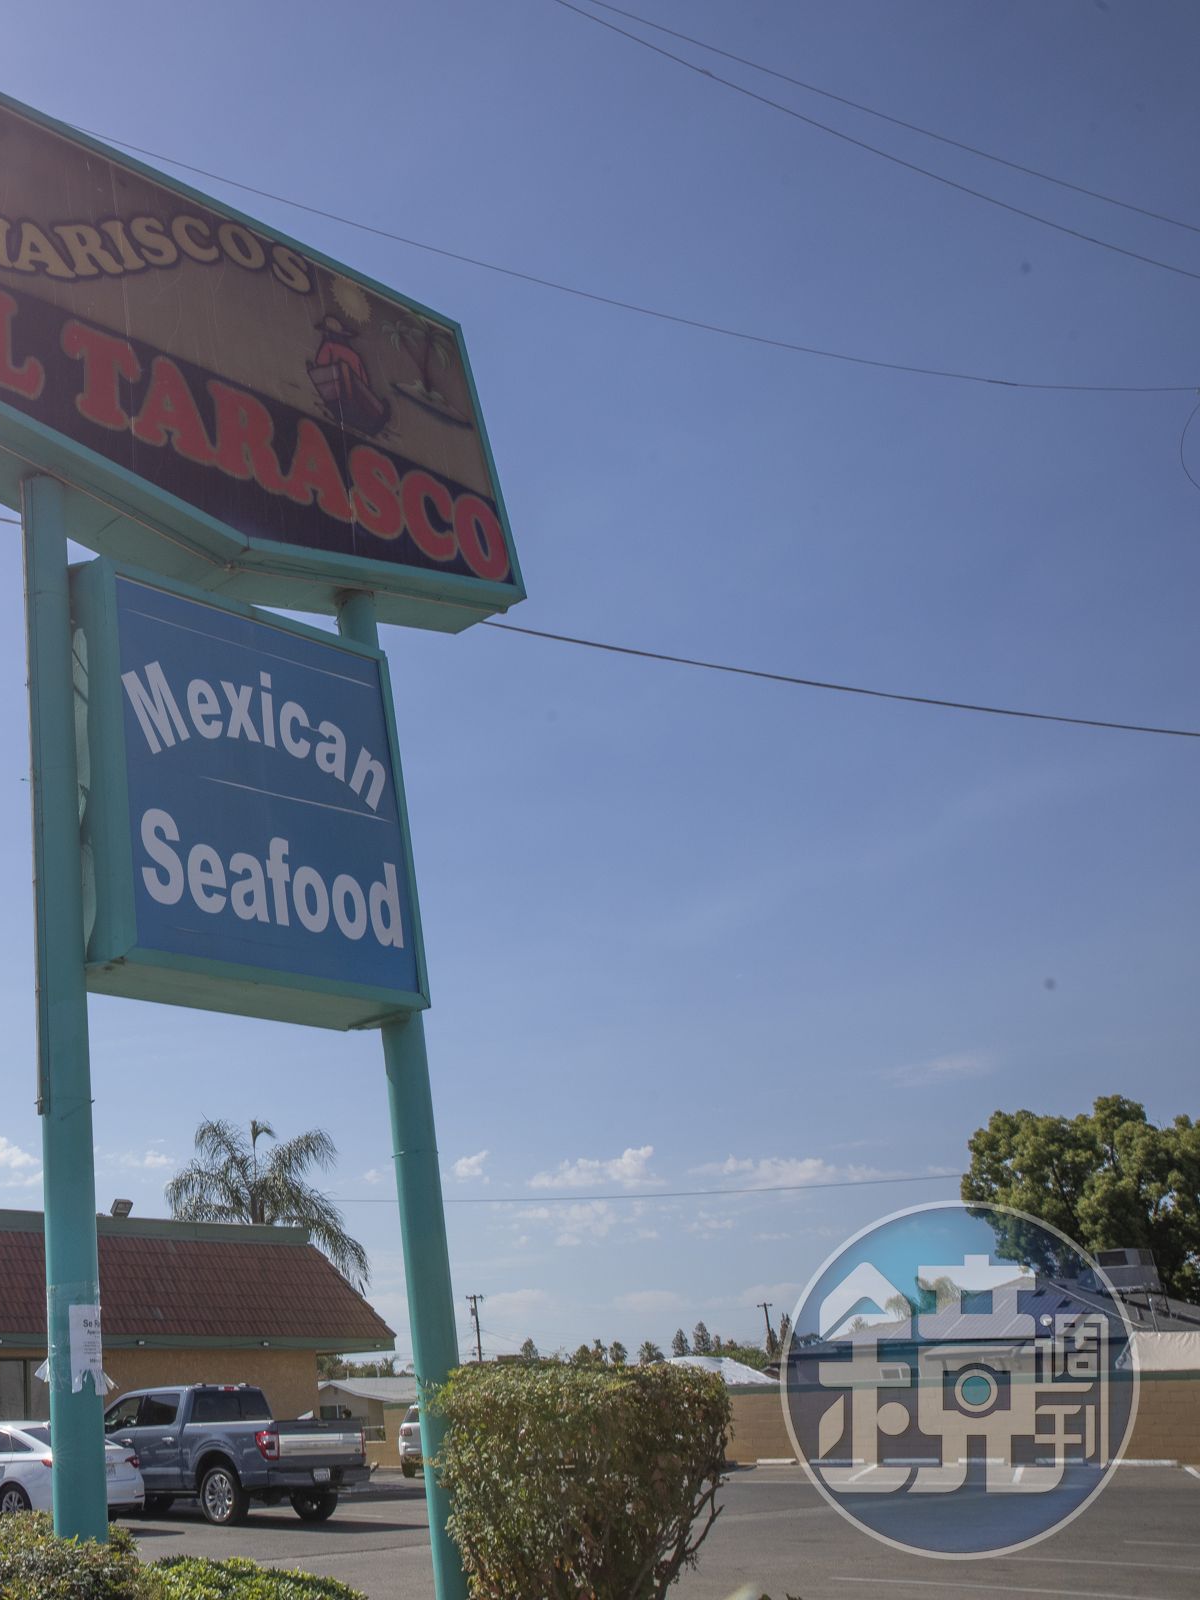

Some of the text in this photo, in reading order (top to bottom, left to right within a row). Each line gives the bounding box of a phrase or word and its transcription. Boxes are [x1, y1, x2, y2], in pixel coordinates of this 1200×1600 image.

[61, 318, 511, 581] TARASCO
[121, 660, 387, 812] Mexican
[140, 808, 404, 949] Seafood
